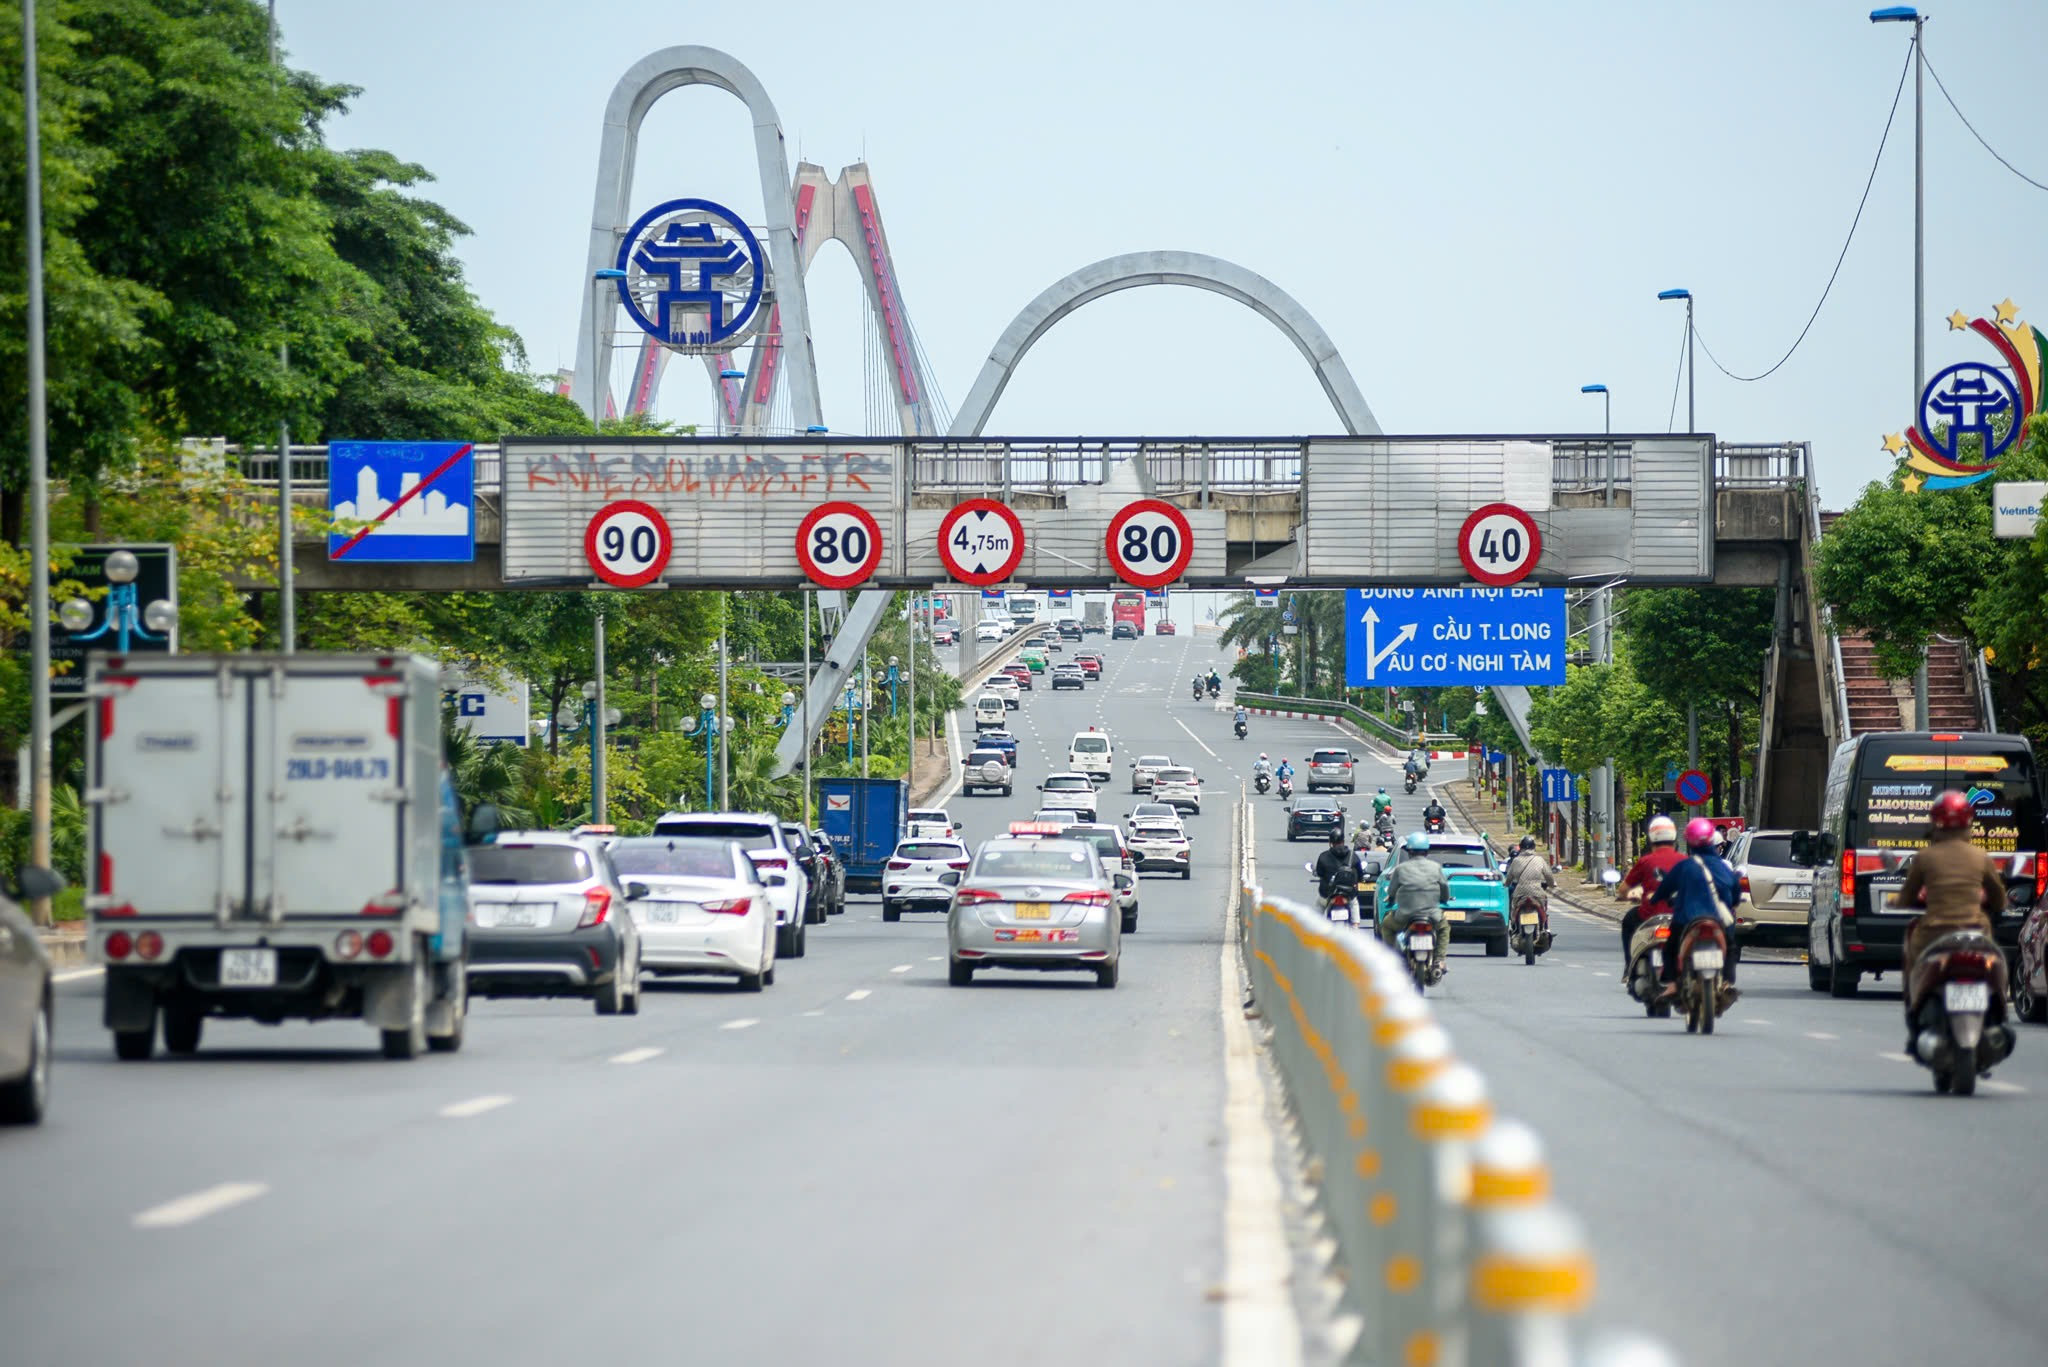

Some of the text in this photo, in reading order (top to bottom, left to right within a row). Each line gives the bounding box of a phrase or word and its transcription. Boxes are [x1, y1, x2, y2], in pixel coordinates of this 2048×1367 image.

[602, 525, 657, 564] 90
[812, 525, 867, 565] 80
[953, 525, 1009, 555] 4,75m
[1121, 525, 1178, 564] 80
[1478, 527, 1522, 564] 40
[1432, 615, 1551, 641] CẦU T.LONG
[1387, 651, 1414, 672] ÂU
[1510, 650, 1551, 671] TÀM
